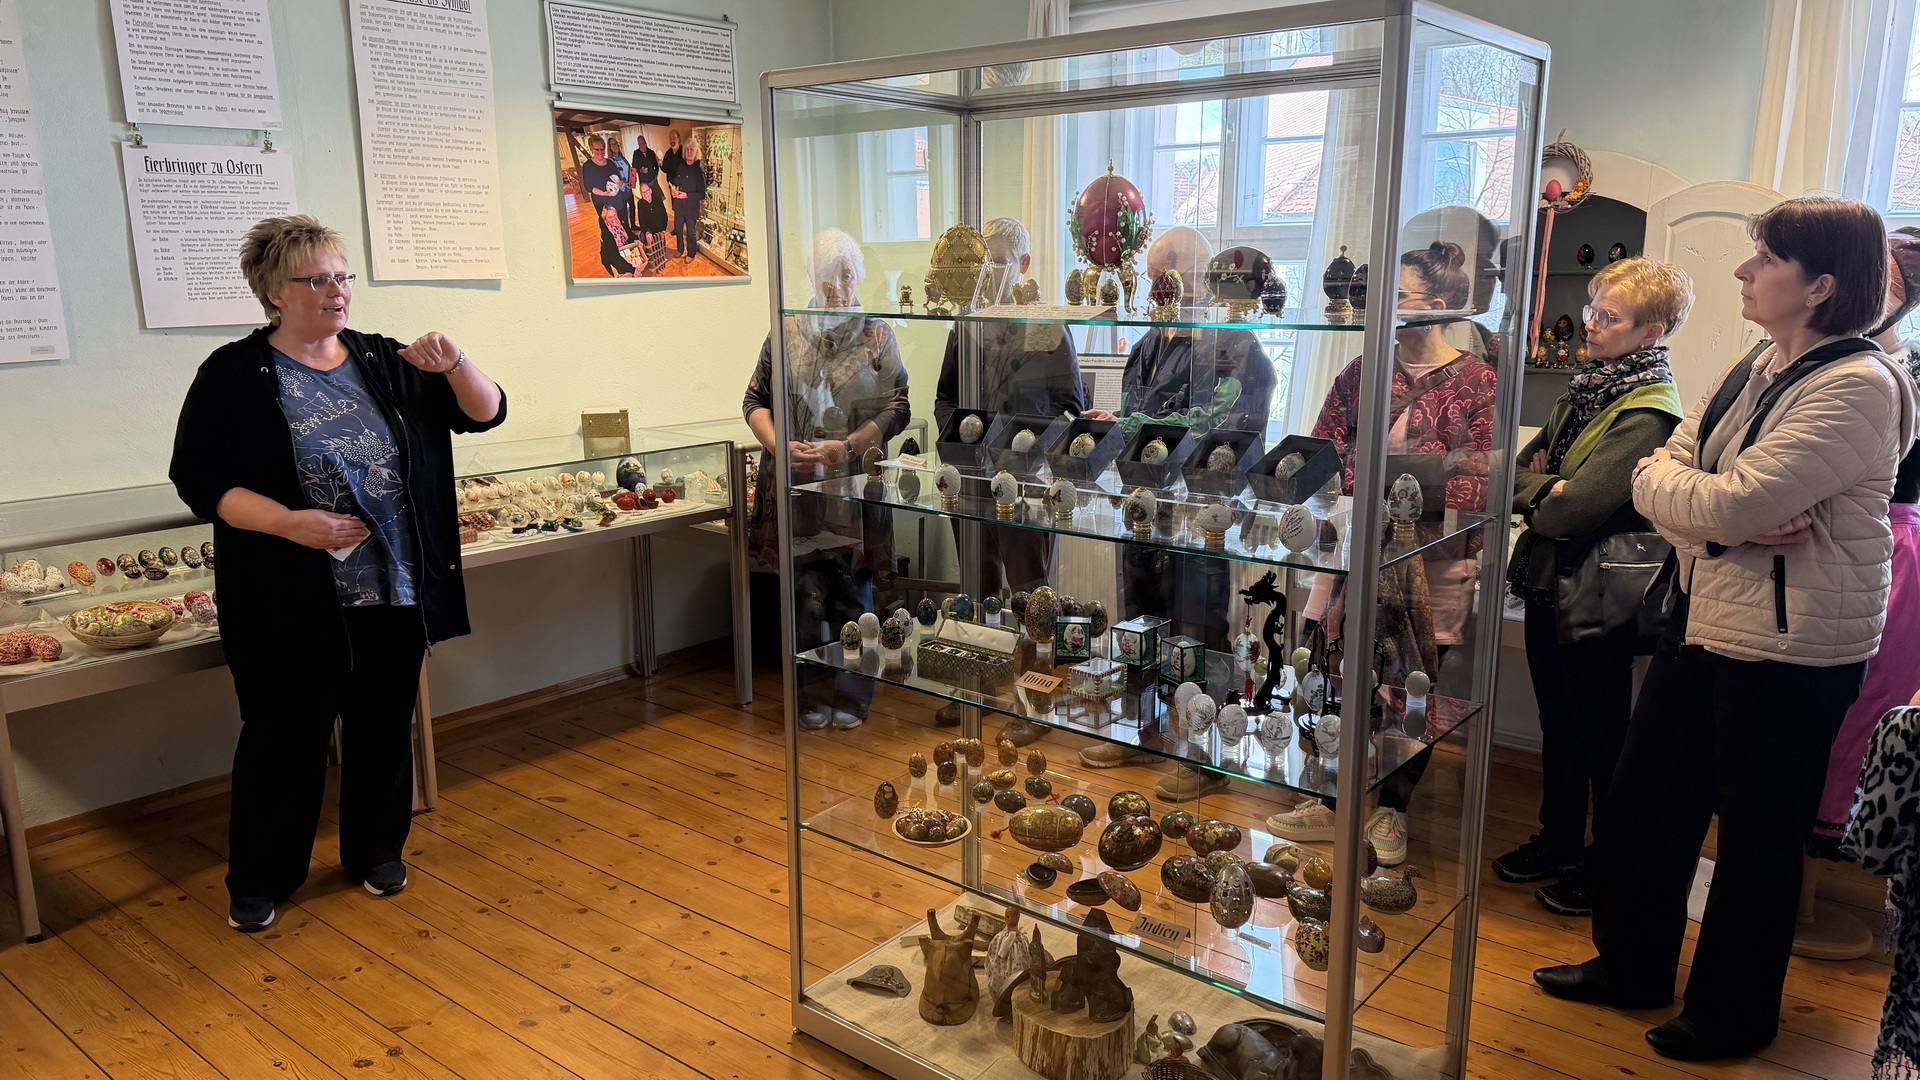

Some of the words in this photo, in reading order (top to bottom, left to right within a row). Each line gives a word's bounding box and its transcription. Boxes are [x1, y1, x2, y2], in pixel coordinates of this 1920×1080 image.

[144, 156, 207, 175] Eierbringer
[211, 162, 223, 174] zu
[226, 160, 263, 175] Ostern
